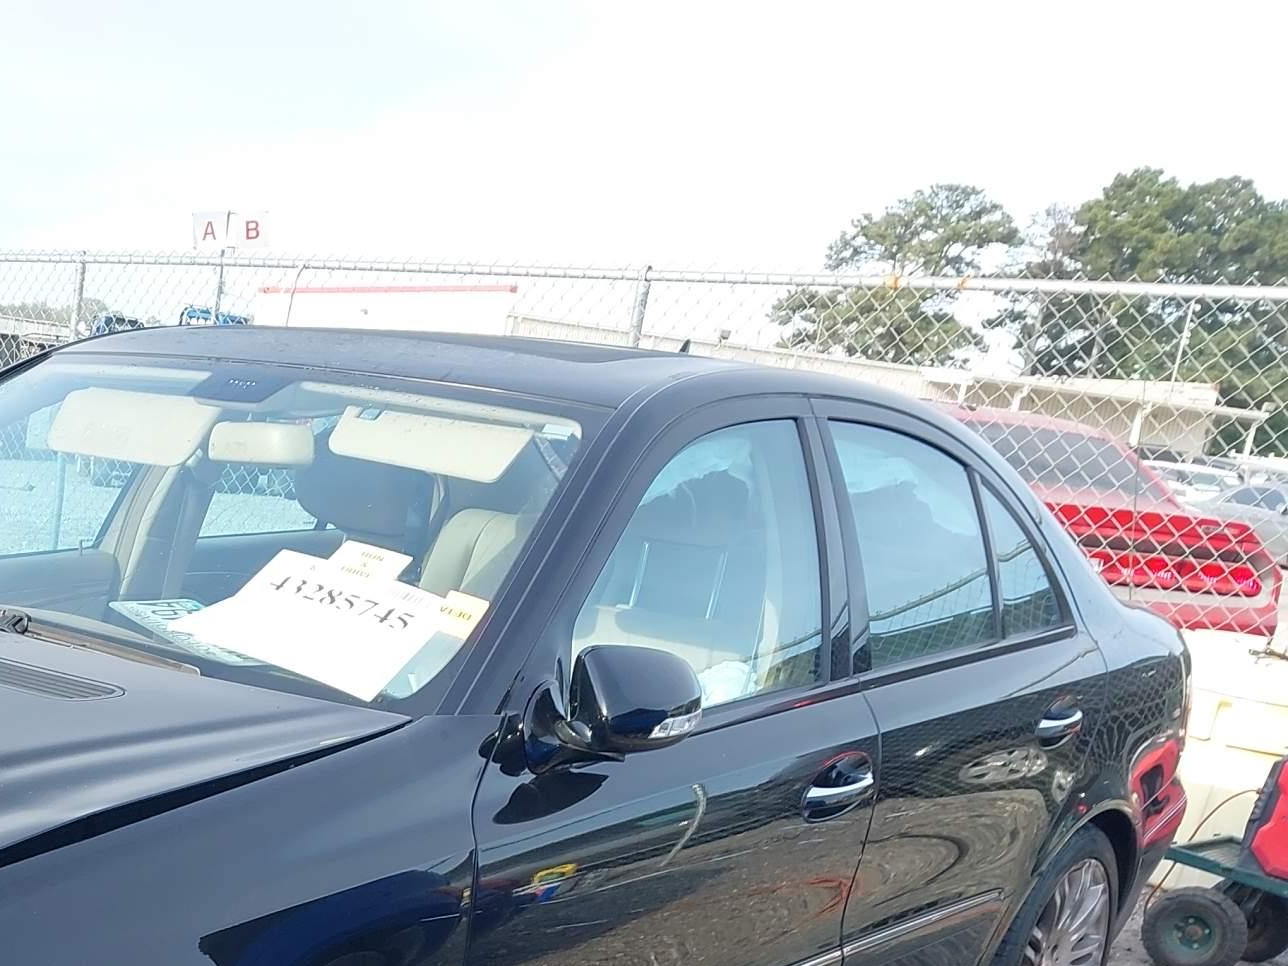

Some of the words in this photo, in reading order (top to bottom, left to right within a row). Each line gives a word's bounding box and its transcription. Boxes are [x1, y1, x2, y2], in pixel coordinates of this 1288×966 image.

[202, 220, 216, 240] A
[245, 220, 260, 240] B
[269, 575, 415, 629] 43285745
